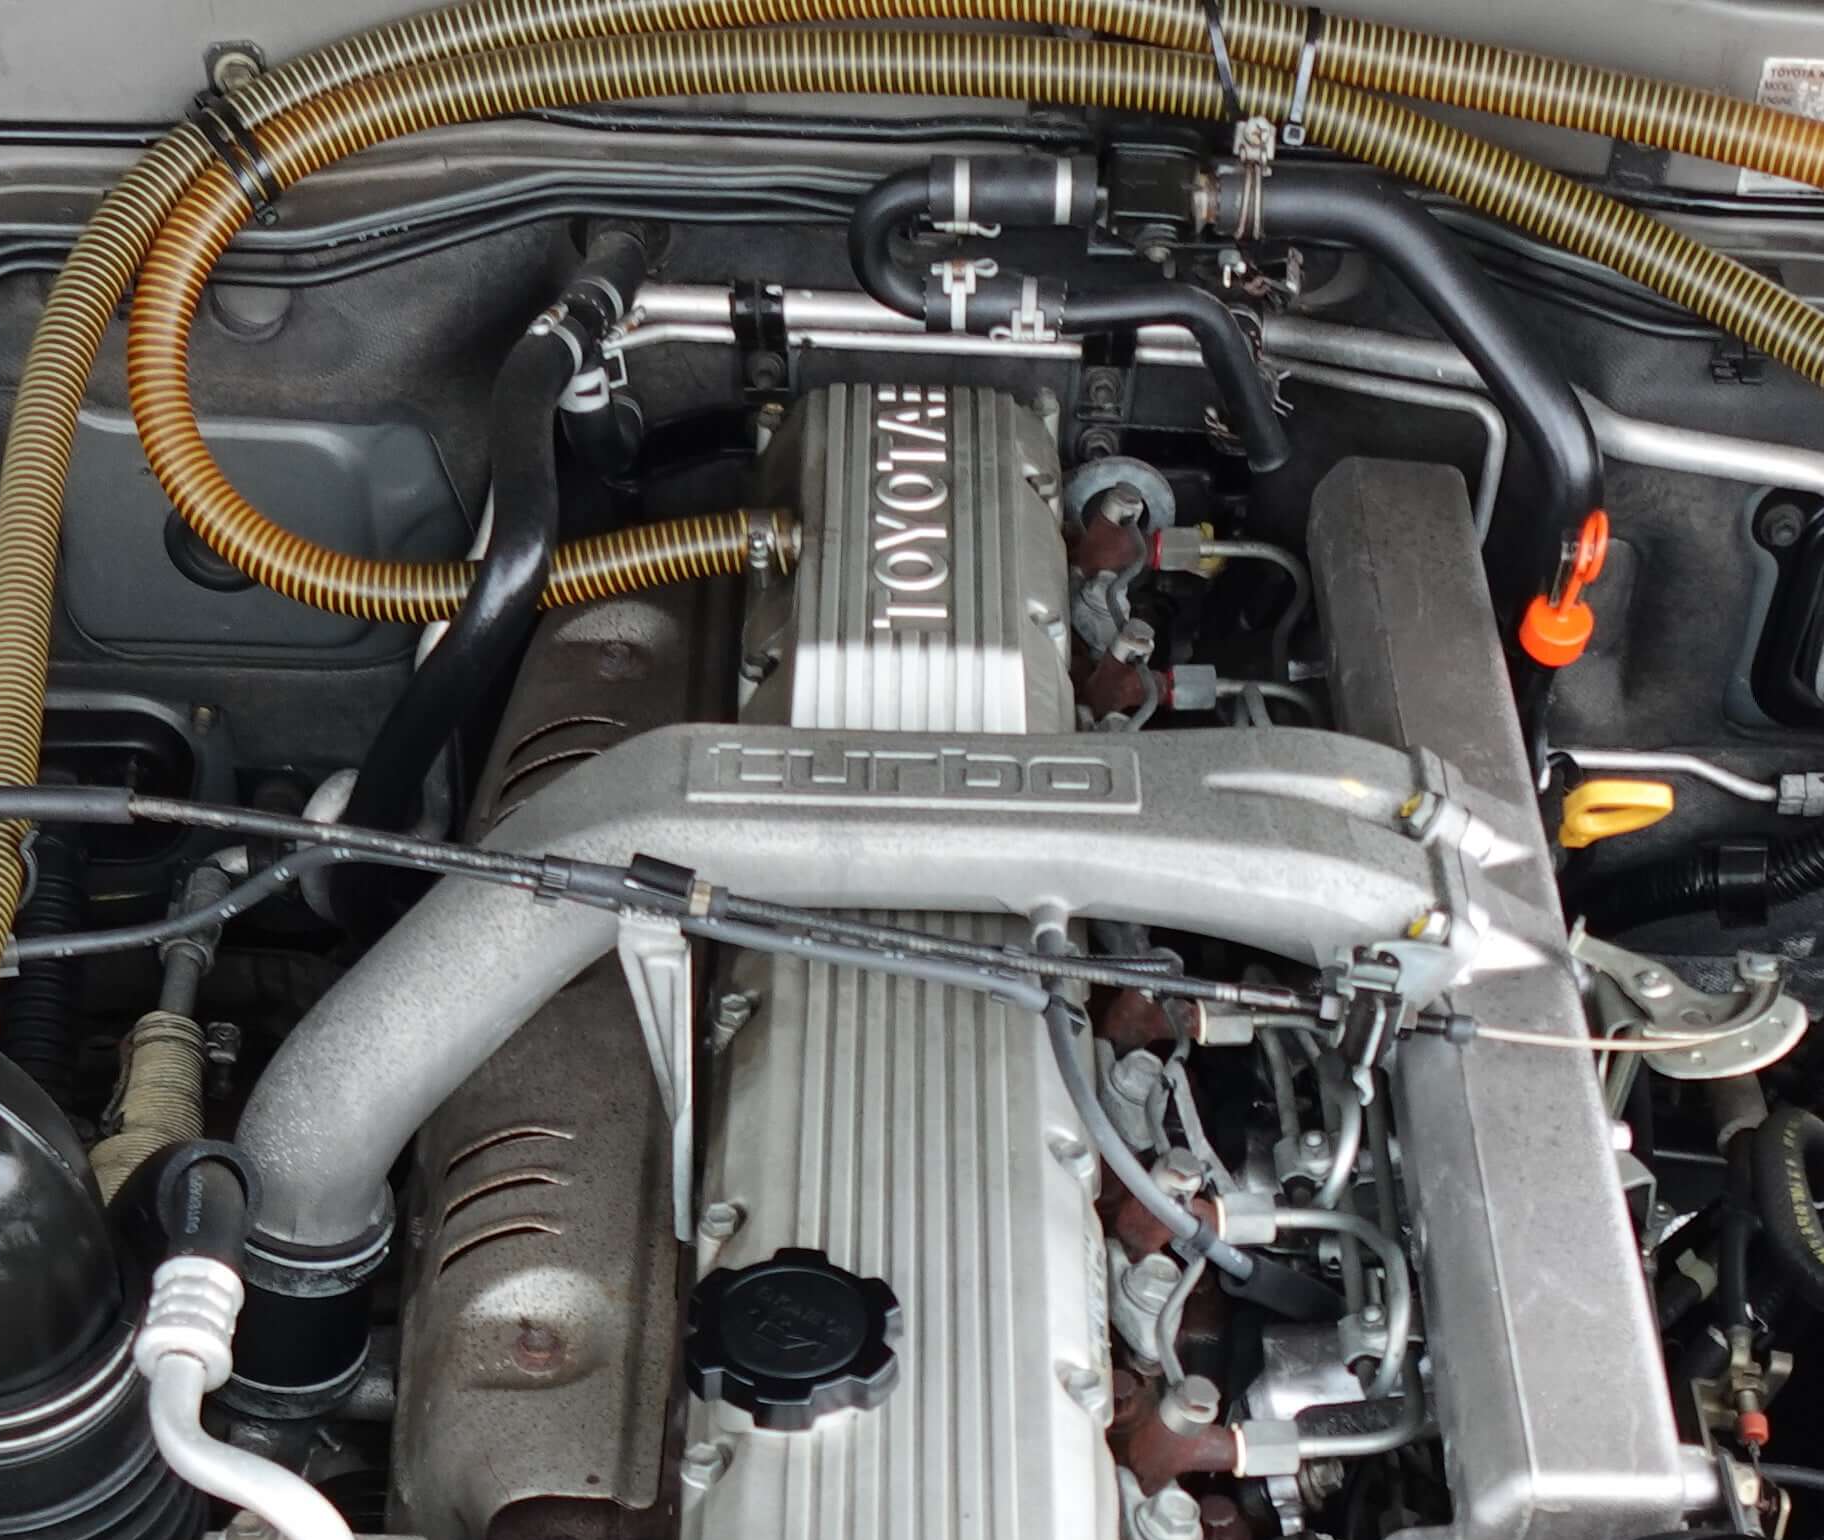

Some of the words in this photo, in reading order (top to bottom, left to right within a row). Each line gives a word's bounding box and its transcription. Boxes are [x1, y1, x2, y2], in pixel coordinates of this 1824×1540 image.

[1770, 68, 1814, 79] TOYOTA
[872, 405, 948, 629] TOYOTA
[707, 742, 1114, 797] turbo
